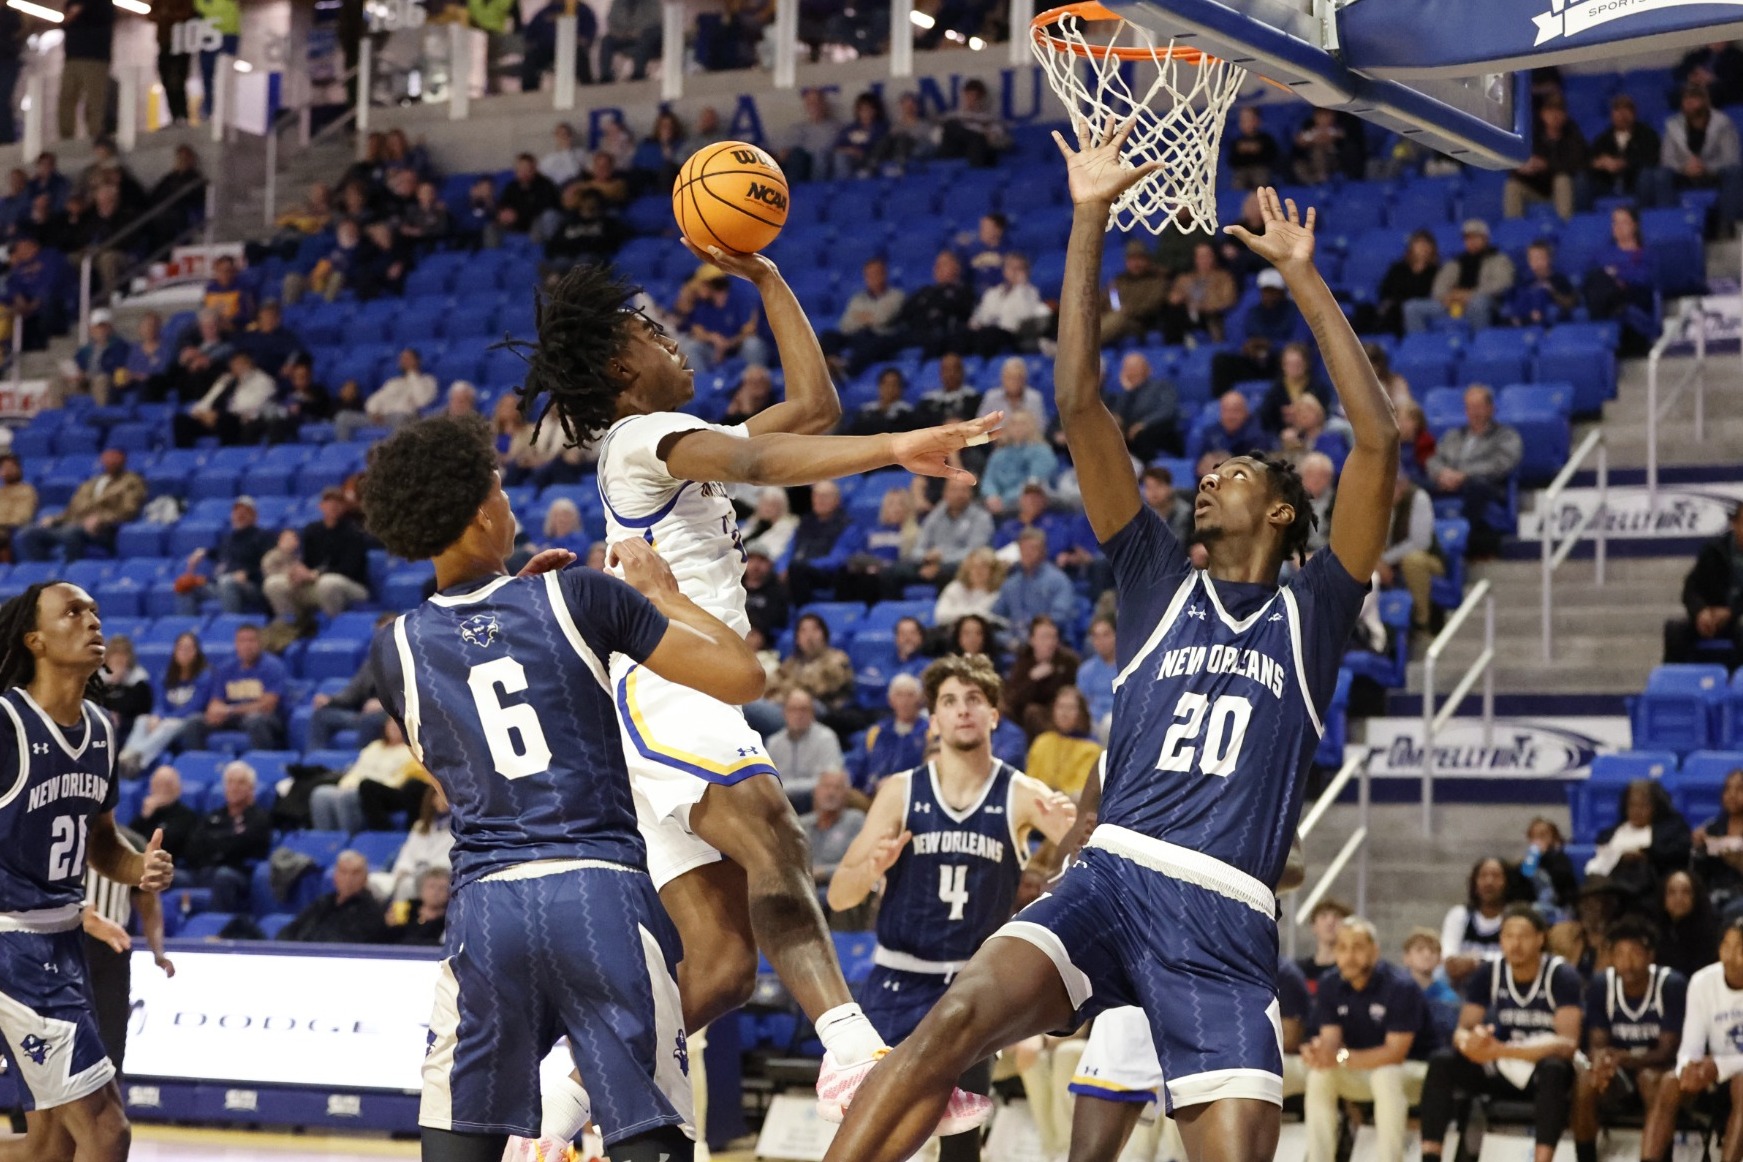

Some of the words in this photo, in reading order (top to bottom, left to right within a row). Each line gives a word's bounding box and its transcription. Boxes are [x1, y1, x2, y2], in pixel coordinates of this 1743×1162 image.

[1589, 0, 1647, 17] SPOR
[746, 182, 787, 212] NCAA
[1157, 647, 1207, 681] NEW
[467, 656, 552, 780] 6
[1155, 692, 1252, 777] 20
[27, 775, 61, 813] NEW
[48, 815, 88, 881] 21
[912, 831, 942, 855] NEW
[941, 831, 1004, 863] ORLEANS
[938, 864, 969, 920] 4
